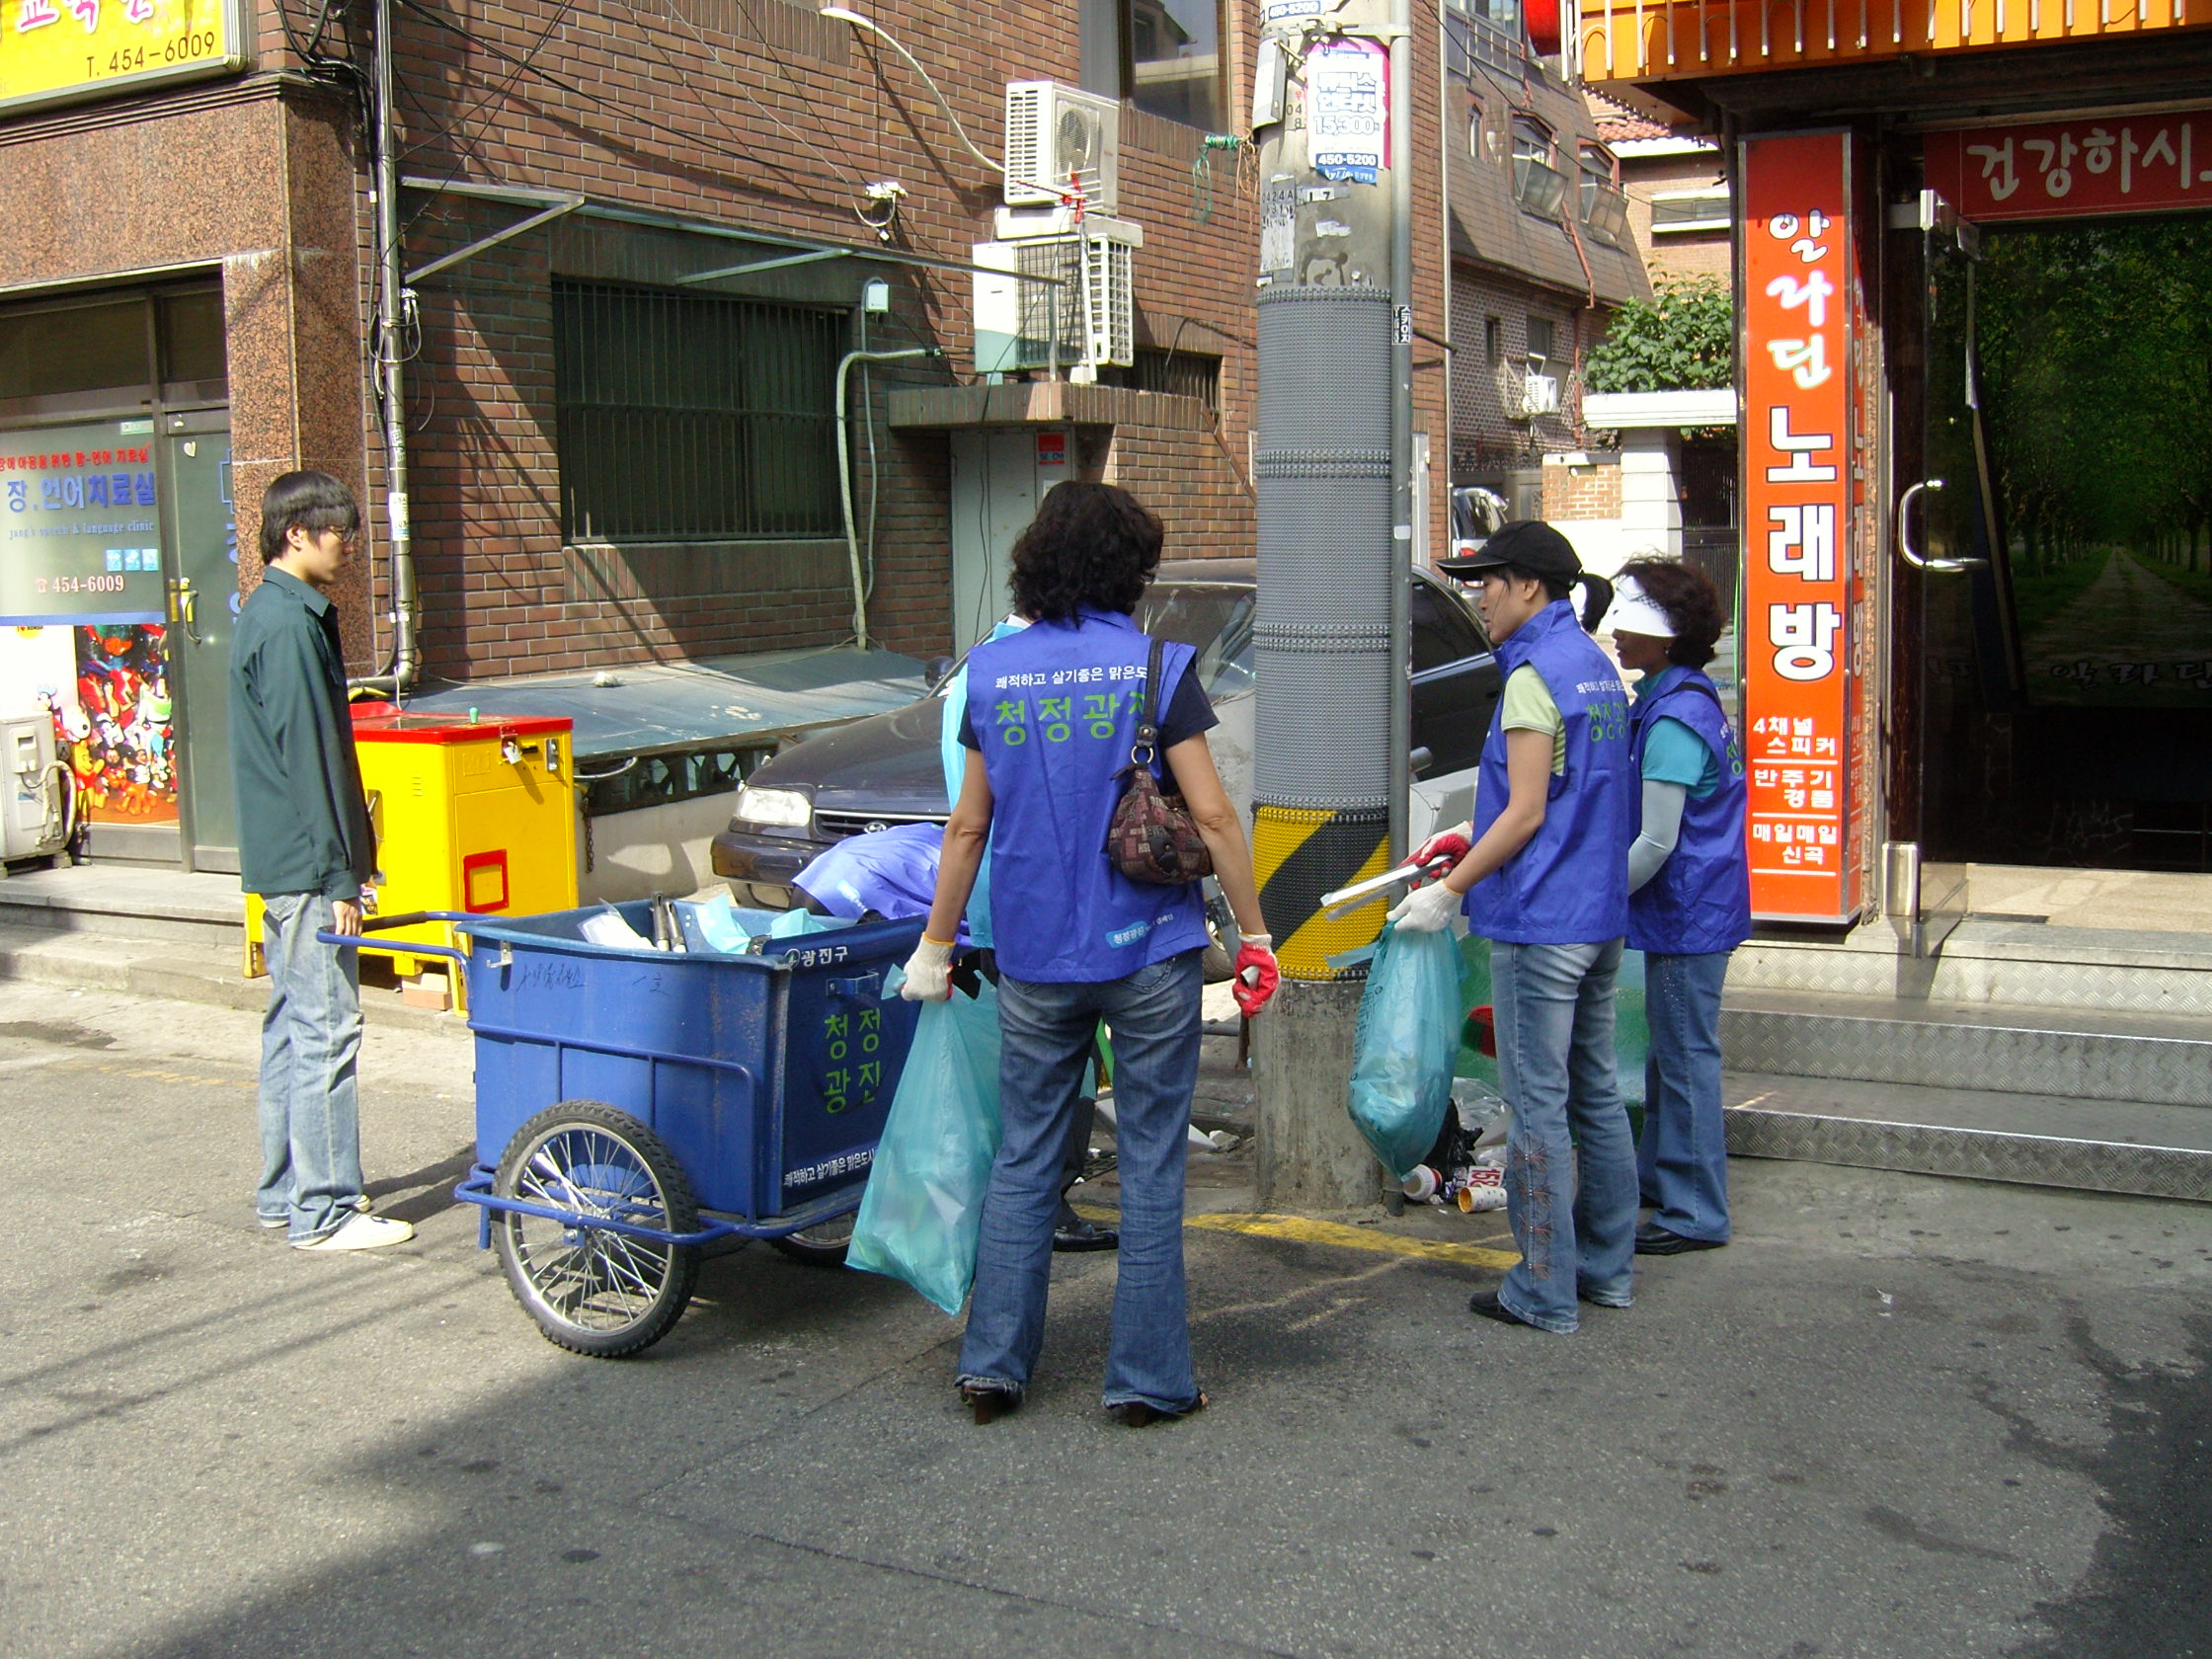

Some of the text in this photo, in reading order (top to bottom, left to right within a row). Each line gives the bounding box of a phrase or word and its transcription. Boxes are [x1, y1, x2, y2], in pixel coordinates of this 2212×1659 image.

[86, 31, 215, 77] T. 454-6009
[1317, 153, 1377, 166] 450-5200
[1966, 122, 2212, 200] 건강하시
[116, 446, 149, 463] 치료실
[71, 523, 80, 534] &
[82, 521, 124, 535] language
[127, 519, 154, 531] clinic
[1765, 405, 1843, 682] 노래방
[52, 575, 125, 592] 454-6009
[995, 665, 1148, 690] 쾌적하고 살기좋은 맑은도
[1753, 716, 1814, 736] 4채널
[1766, 737, 1837, 756] 스피커
[1754, 769, 1833, 789] 반주기
[1752, 823, 1838, 845] 매일매일
[1781, 845, 1824, 865] 신곡
[801, 946, 849, 968] 광진구
[824, 1007, 881, 1061] 청정
[824, 1060, 881, 1115] 광진
[816, 1156, 847, 1181] 살기좋은
